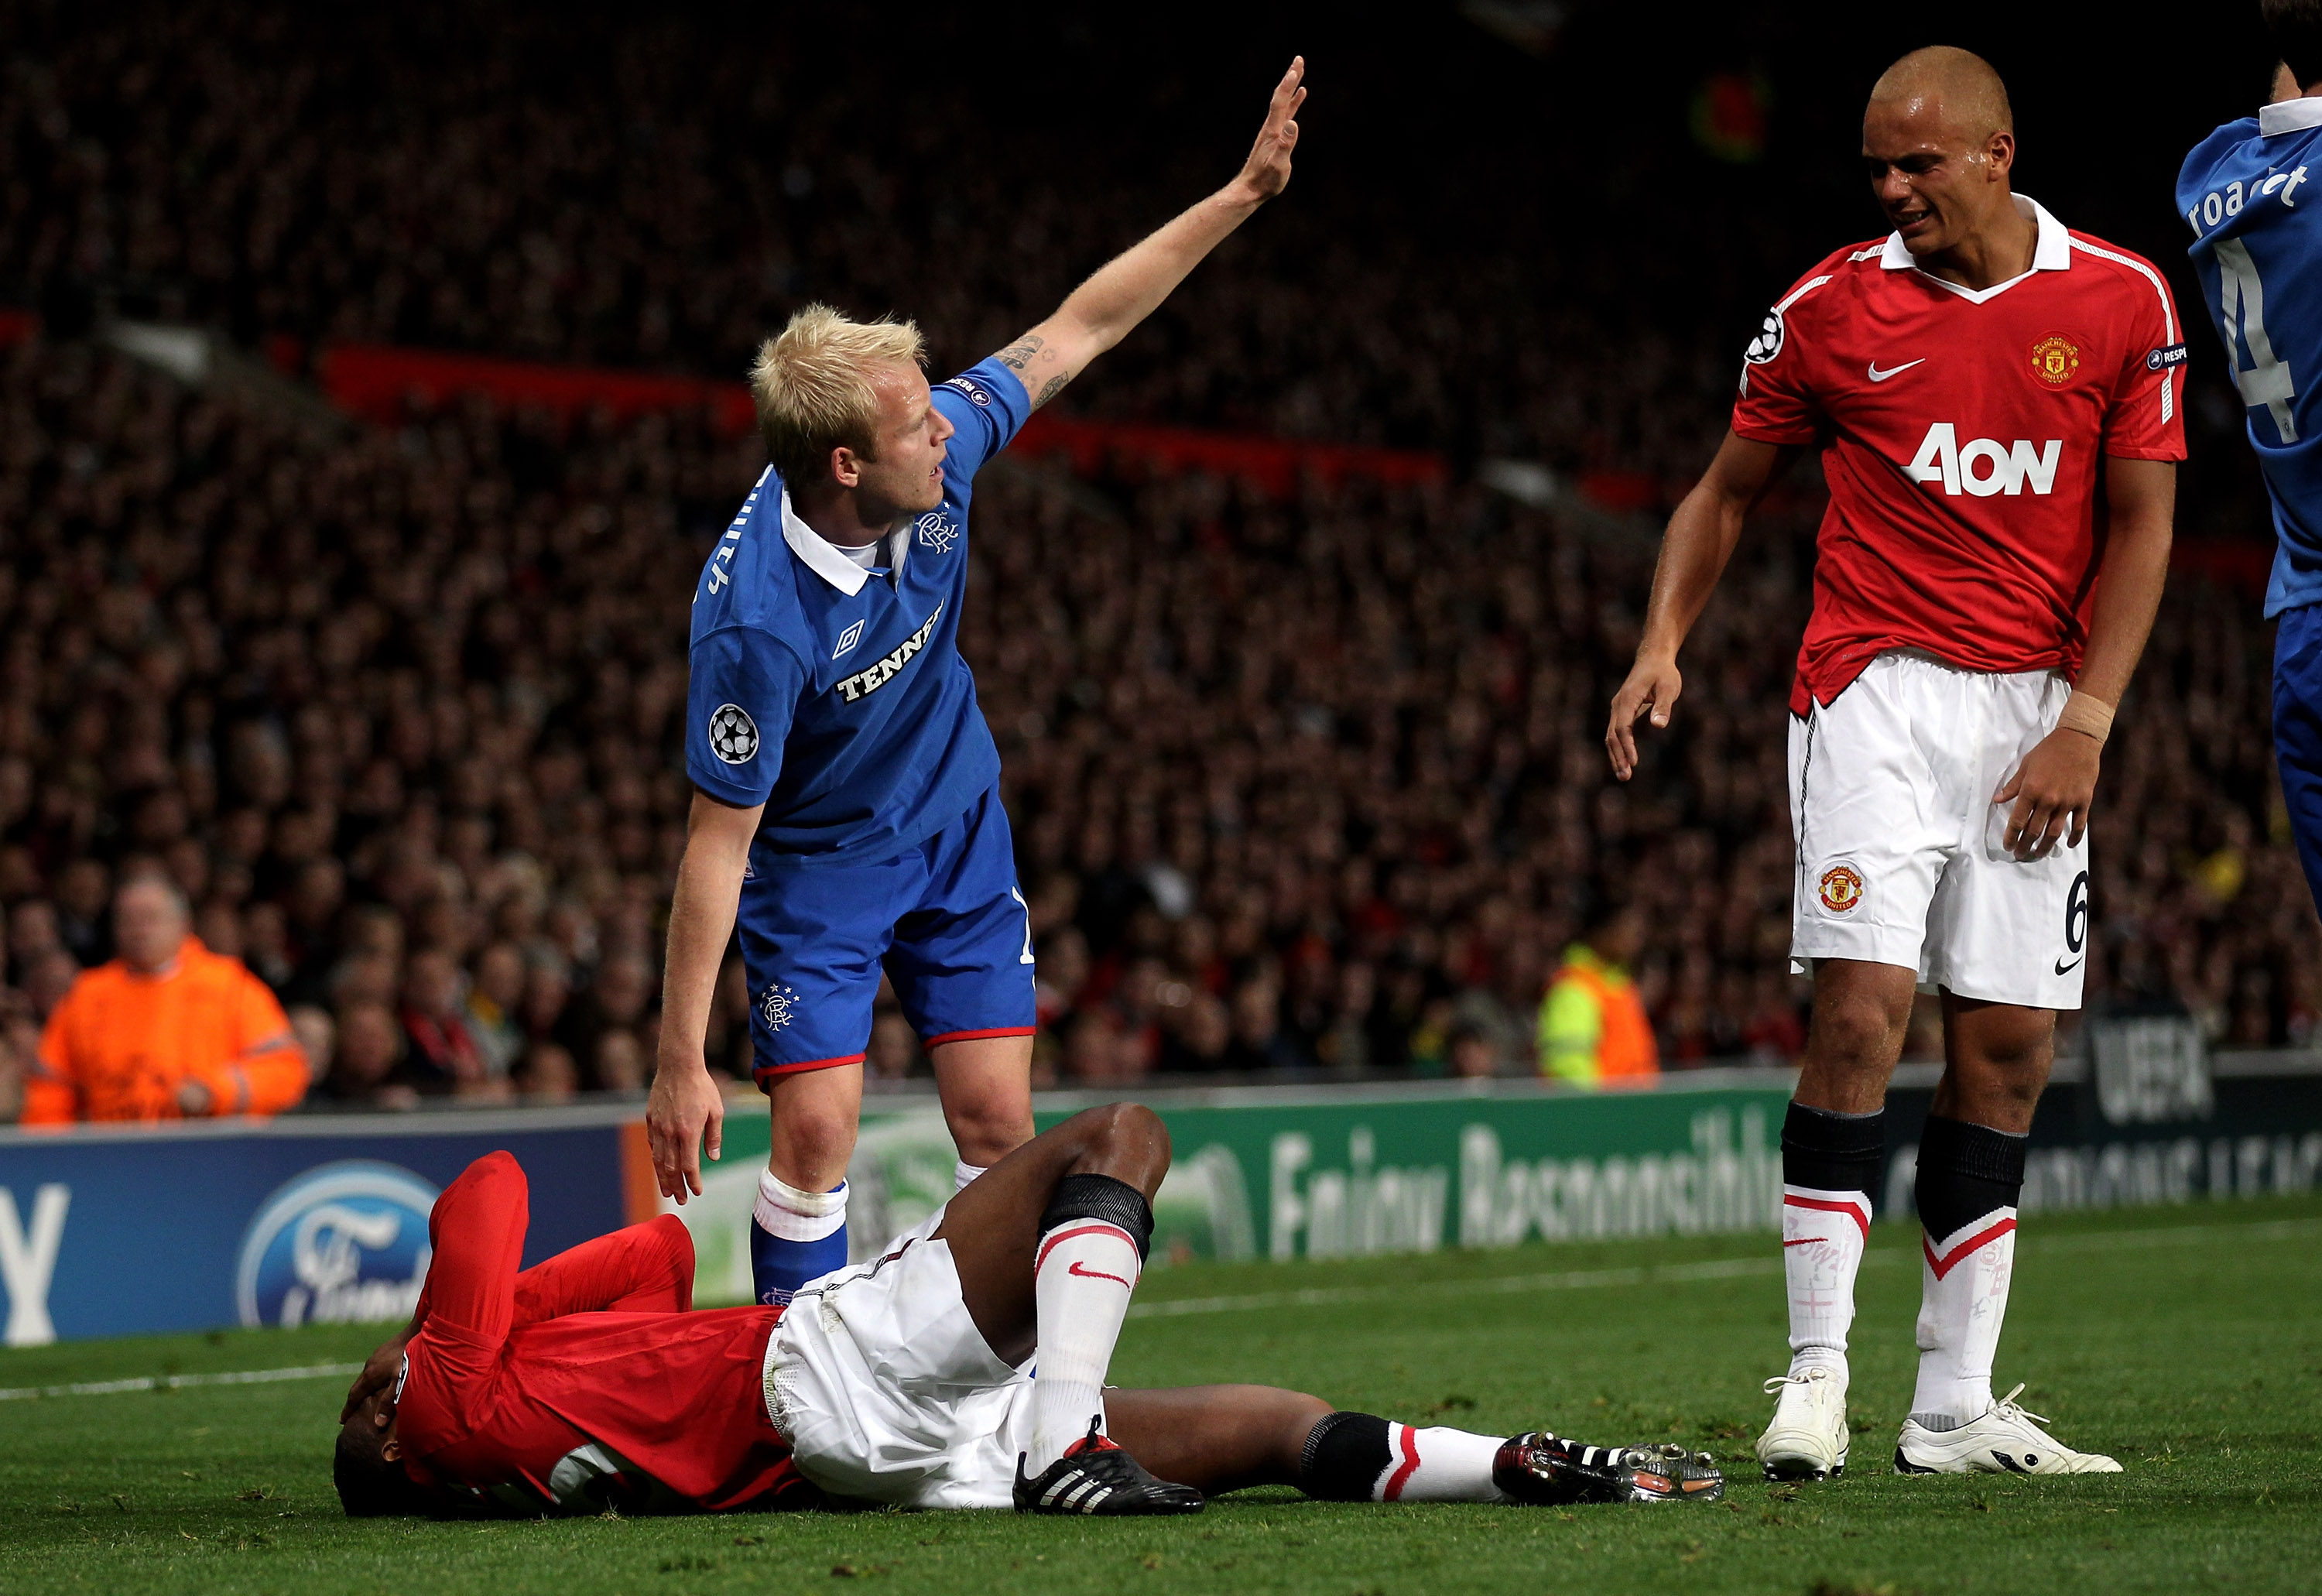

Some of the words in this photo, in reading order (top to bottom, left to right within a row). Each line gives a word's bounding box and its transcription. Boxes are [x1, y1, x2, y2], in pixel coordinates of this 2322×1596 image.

[2037, 340, 2074, 356] MANCHESTER
[2214, 236, 2300, 444] 4
[2042, 372, 2069, 380] UNITED
[1824, 869, 1858, 886] MANCHESTER
[1827, 900, 1852, 909] UNITED
[2065, 869, 2088, 954] 6
